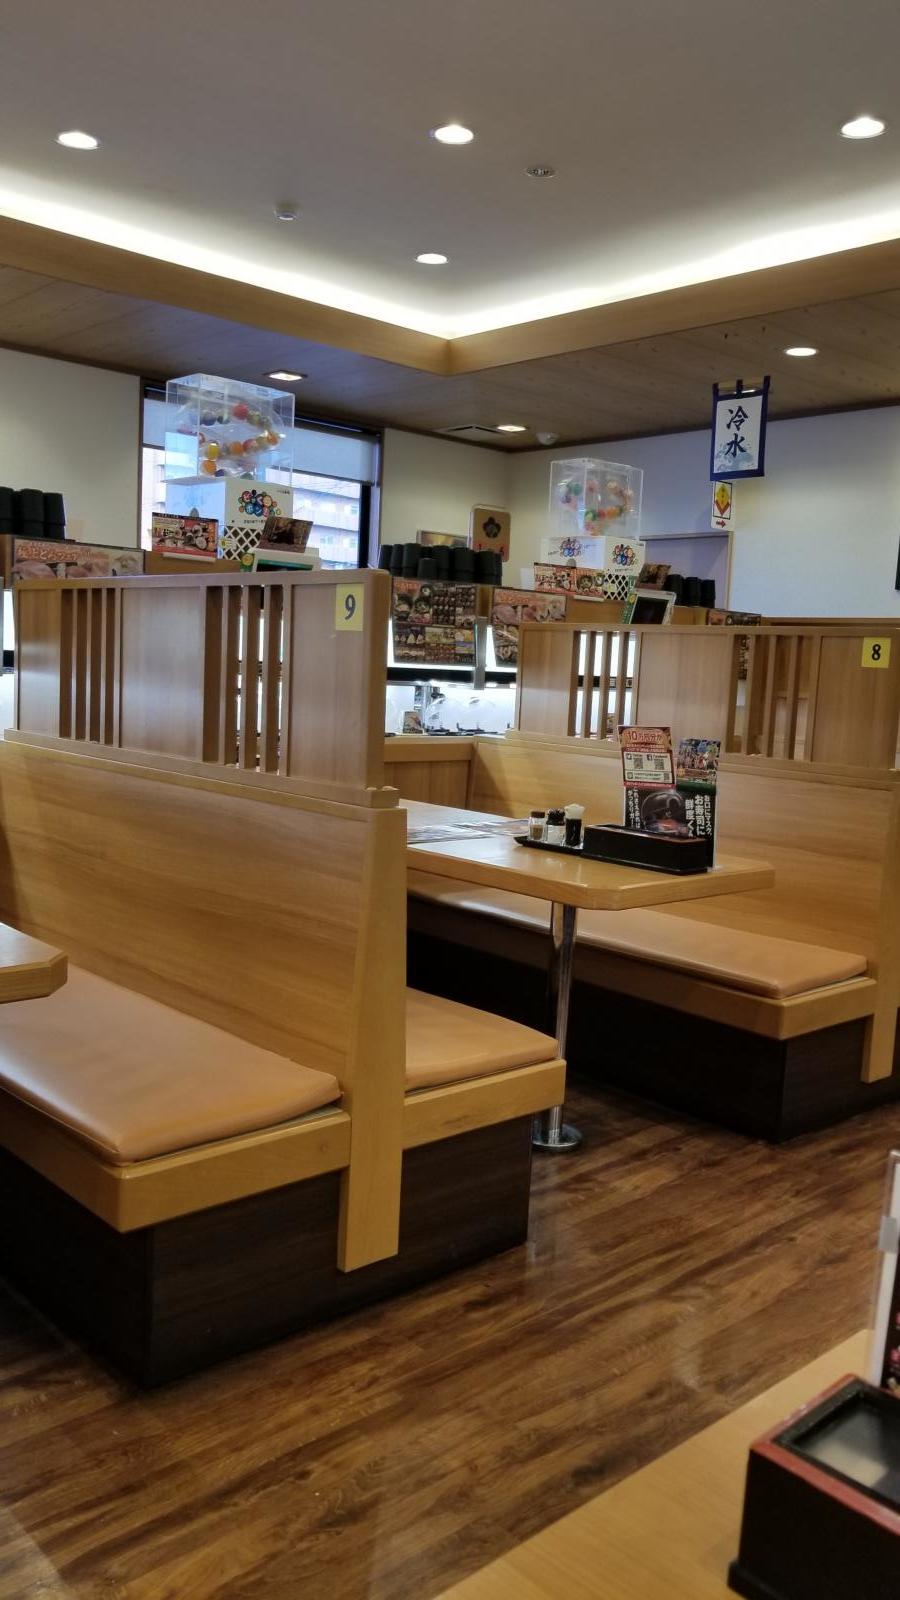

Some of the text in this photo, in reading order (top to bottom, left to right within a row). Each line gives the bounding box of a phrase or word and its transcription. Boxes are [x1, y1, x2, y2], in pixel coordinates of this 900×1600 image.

[725, 405, 749, 458] 冷水
[345, 594, 356, 620] 9
[871, 643, 882, 661] 8
[695, 794, 706, 836] お寿司に
